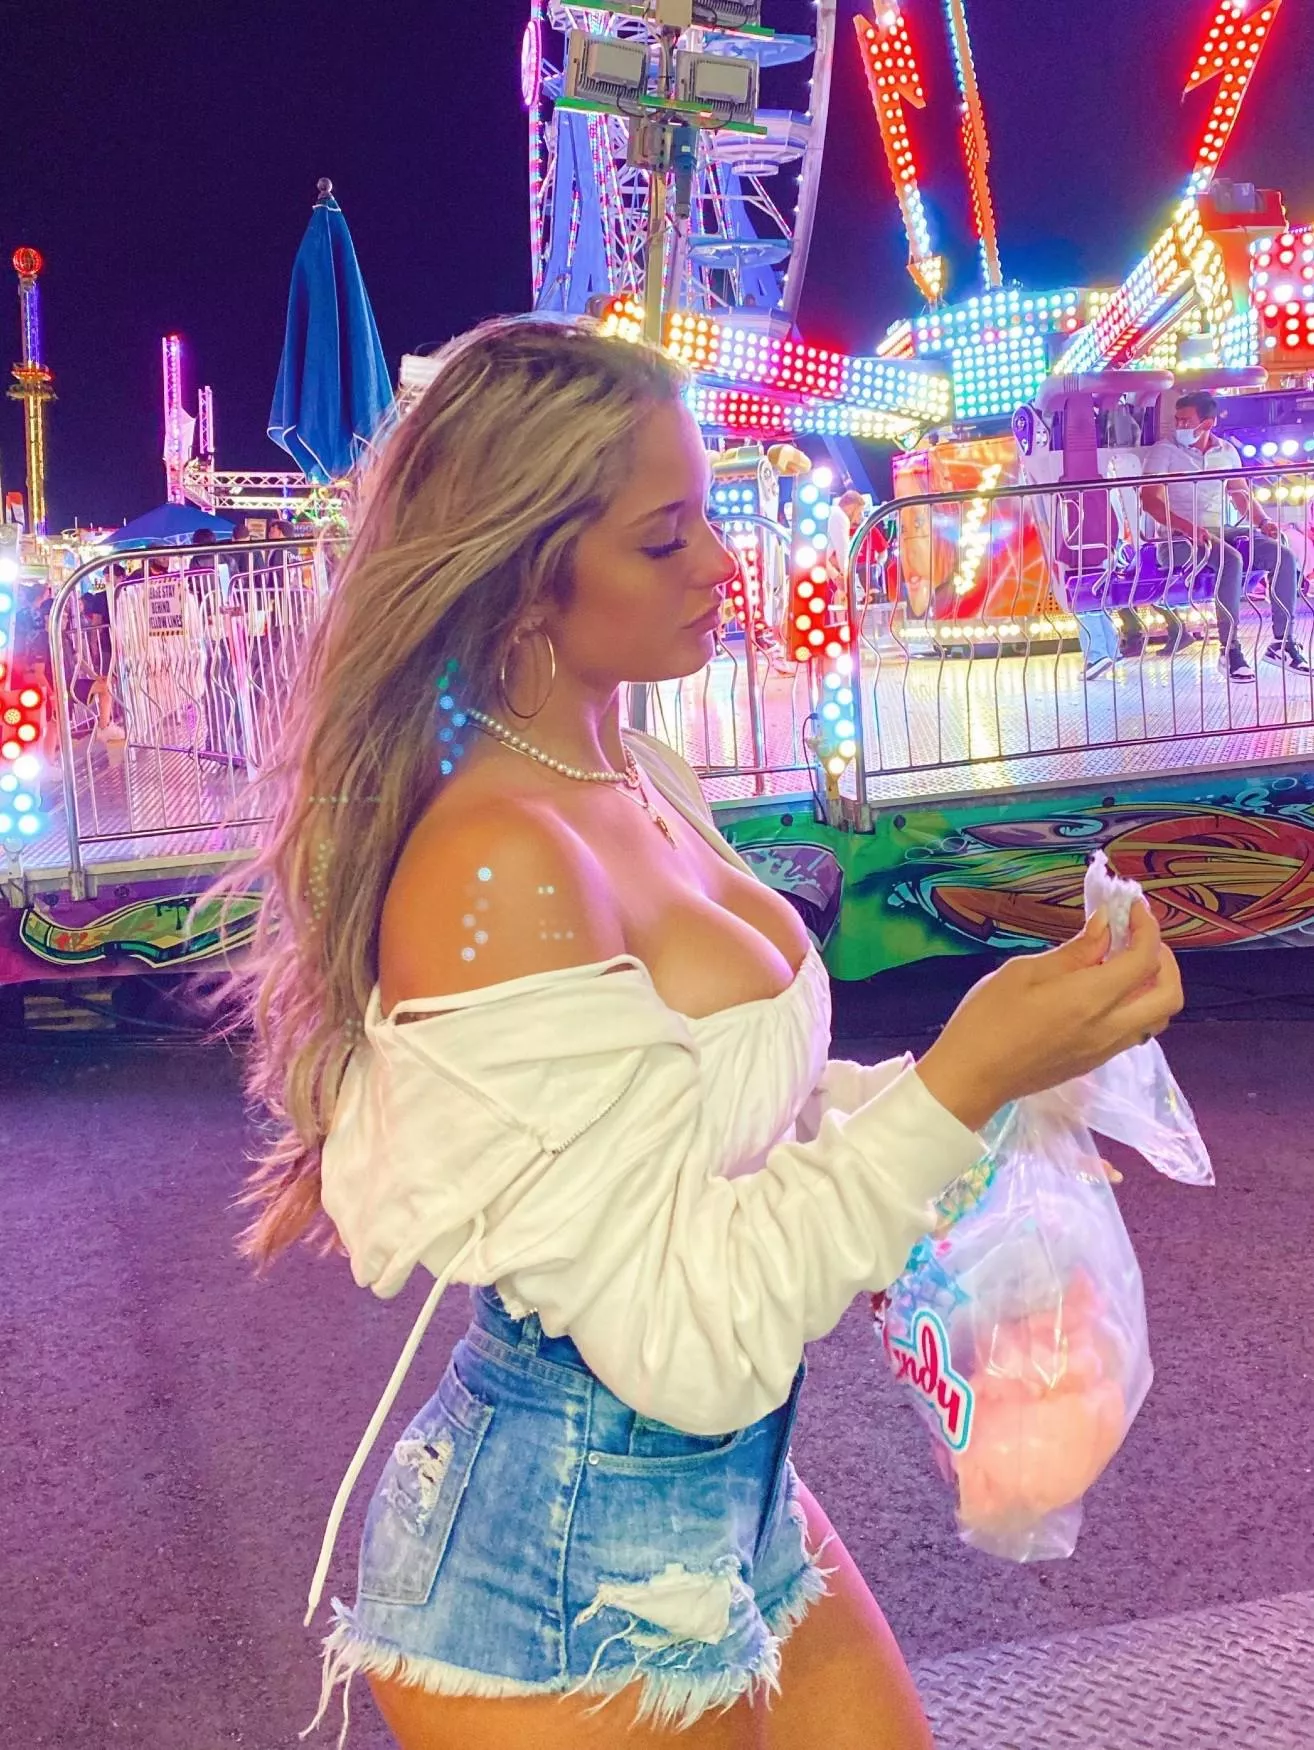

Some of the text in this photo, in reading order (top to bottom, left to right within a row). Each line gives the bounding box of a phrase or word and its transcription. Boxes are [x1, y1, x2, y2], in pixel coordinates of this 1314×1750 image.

[149, 585, 175, 599] EASE STAY
[152, 601, 170, 614] BEHIND
[167, 615, 183, 628] LINES
